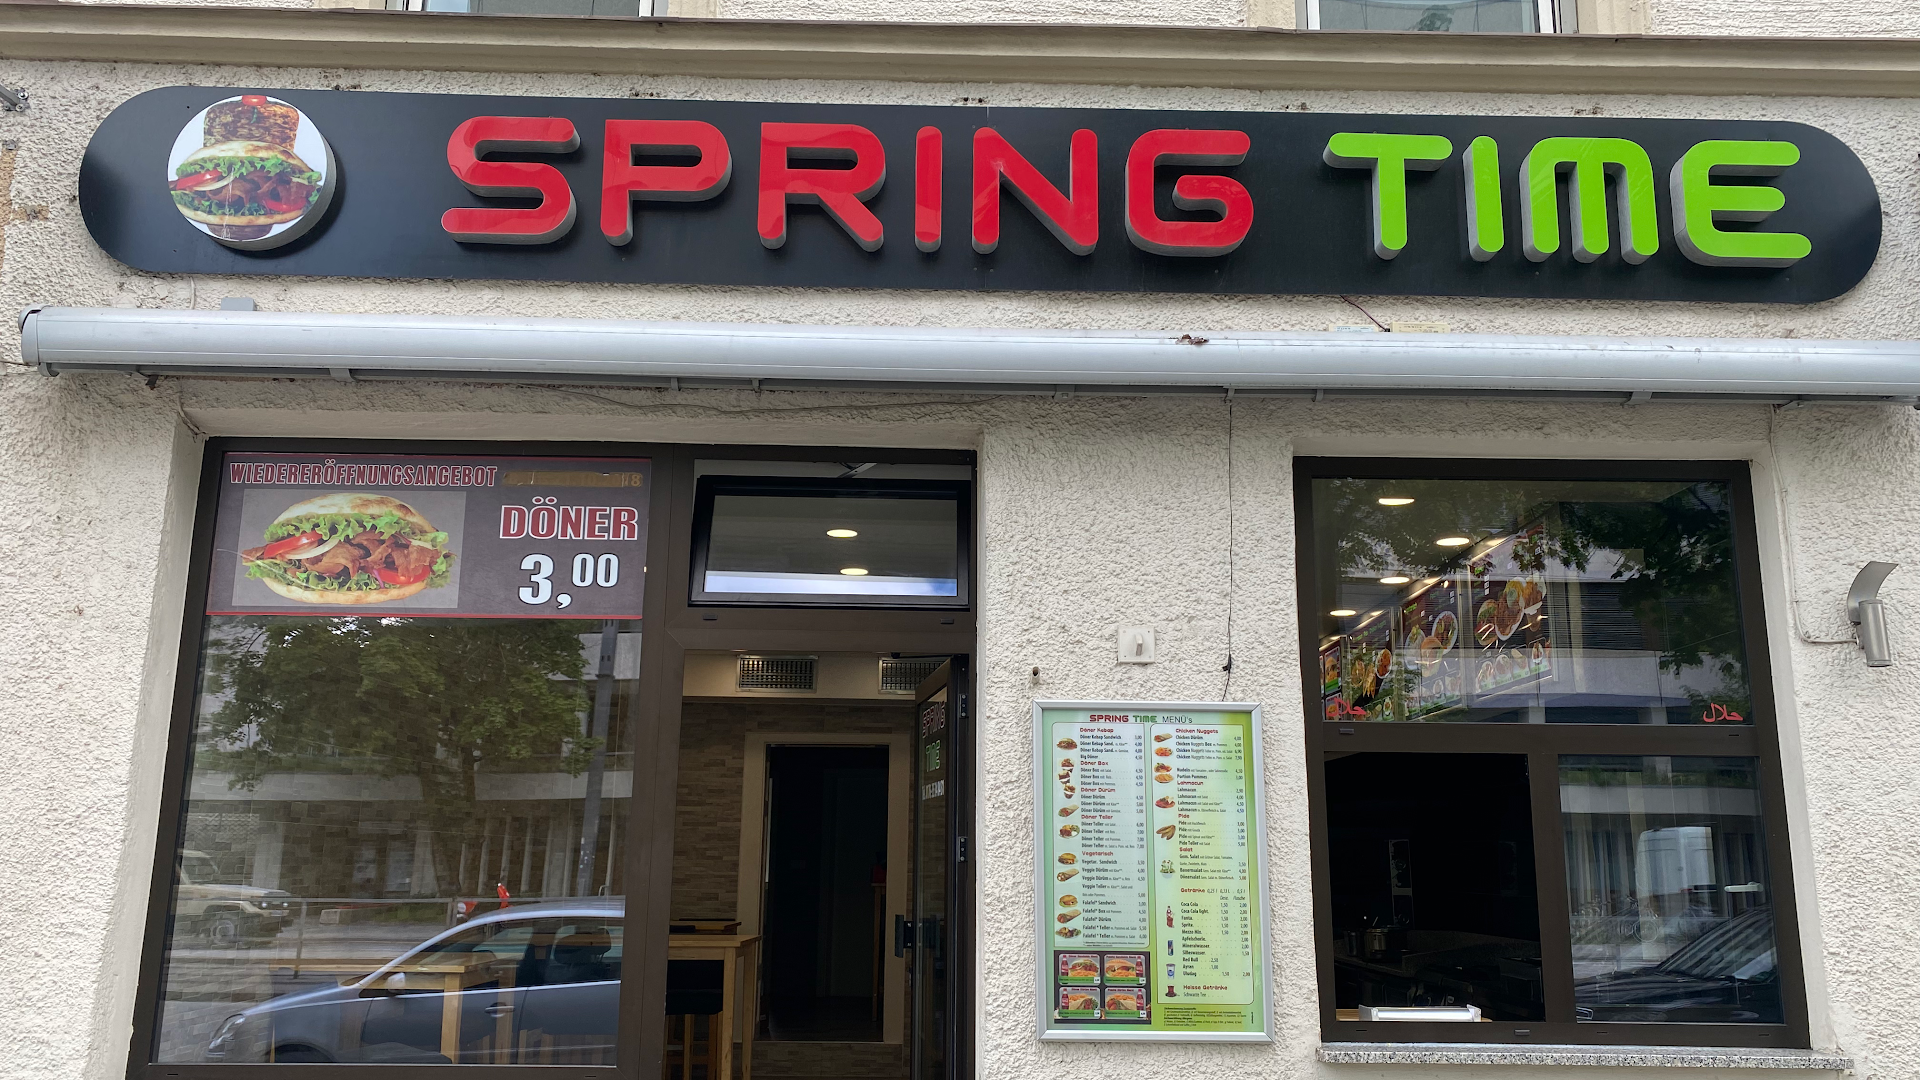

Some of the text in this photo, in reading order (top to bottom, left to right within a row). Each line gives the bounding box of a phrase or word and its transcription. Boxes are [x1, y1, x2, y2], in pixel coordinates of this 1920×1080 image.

[441, 115, 1812, 265] SPRING TIME
[229, 459, 498, 487] WIEDERERÖFFNUNGSANGEBOT
[499, 496, 638, 541] DÖNER
[519, 553, 619, 608] 3,00
[922, 700, 945, 738] SPRING
[1090, 714, 1193, 723] SPRING TIME MENÜ's
[1326, 697, 1367, 717] حلال
[1703, 703, 1743, 723] حلال
